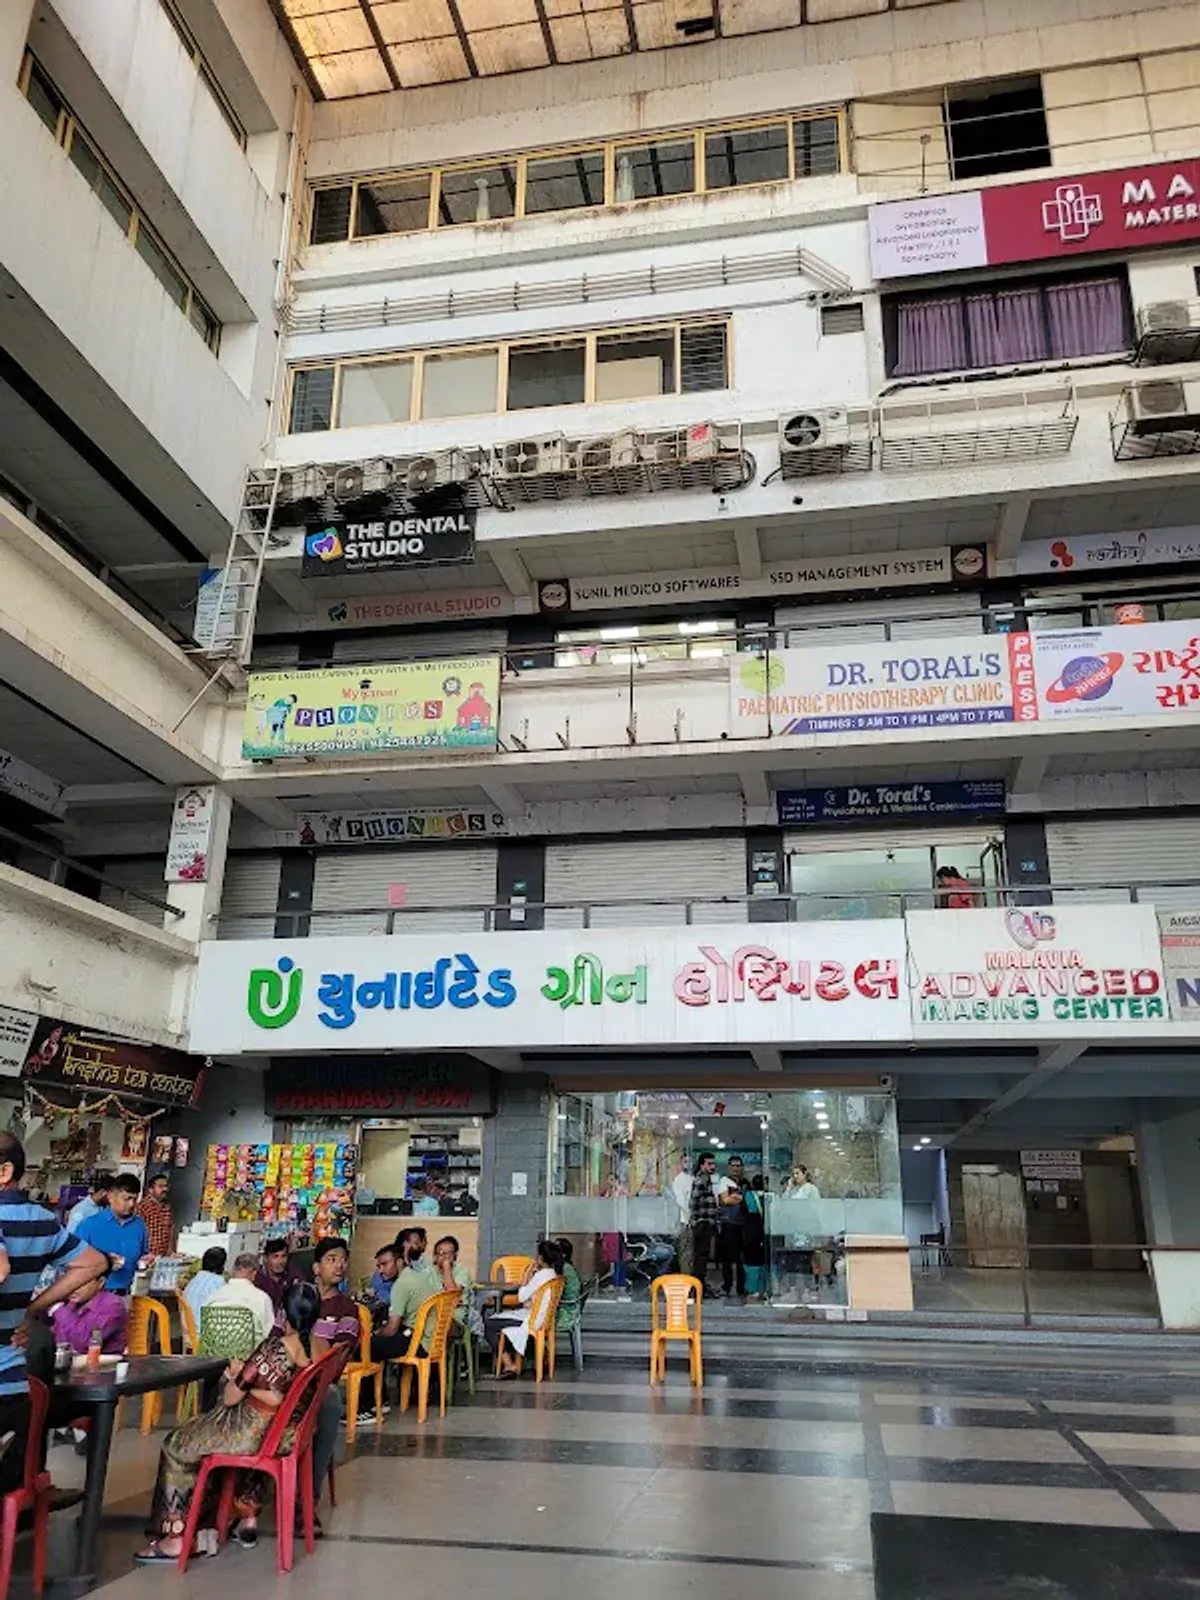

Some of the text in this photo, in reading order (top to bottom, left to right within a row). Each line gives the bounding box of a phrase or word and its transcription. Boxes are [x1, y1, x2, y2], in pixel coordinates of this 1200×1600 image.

[1123, 175, 1196, 206] MA
[1127, 209, 1200, 231] MATER
[346, 514, 472, 541] THE DENTAL
[344, 538, 424, 560] STUDIO
[769, 571, 794, 586] SSD
[797, 563, 889, 583] MANAGEMENT
[893, 558, 944, 575] SYSTEM
[575, 585, 611, 600] SUNIL
[613, 581, 662, 598] MEDICO
[664, 575, 740, 594] SOFTWARES
[353, 604, 382, 620] THE
[385, 600, 443, 617] DENTAL
[445, 595, 502, 613] STUDIO
[827, 652, 1001, 687] DR. TORAL'S
[1014, 636, 1036, 720] PRESS
[738, 681, 1004, 717] PAEDIATRIC PHYSIOTHERAPY CLINIC
[296, 701, 442, 727] PHONICS
[866, 716, 884, 727] AM
[886, 715, 900, 726] TO
[911, 713, 928, 724] PM
[962, 711, 976, 722] TO
[987, 709, 1005, 721] PM
[336, 726, 393, 737] HOUSE
[848, 785, 932, 806] Dr. Toral's
[349, 814, 486, 840] PHONICS
[985, 950, 1084, 970] MALAVIA
[317, 944, 900, 1030] યુનાઈટેડ ગ્રીન હોસ્પિટલ
[920, 969, 1160, 999] ADVANCED
[920, 996, 1165, 1021] IMAGING CENTER
[275, 1087, 409, 1111] PHARMACY
